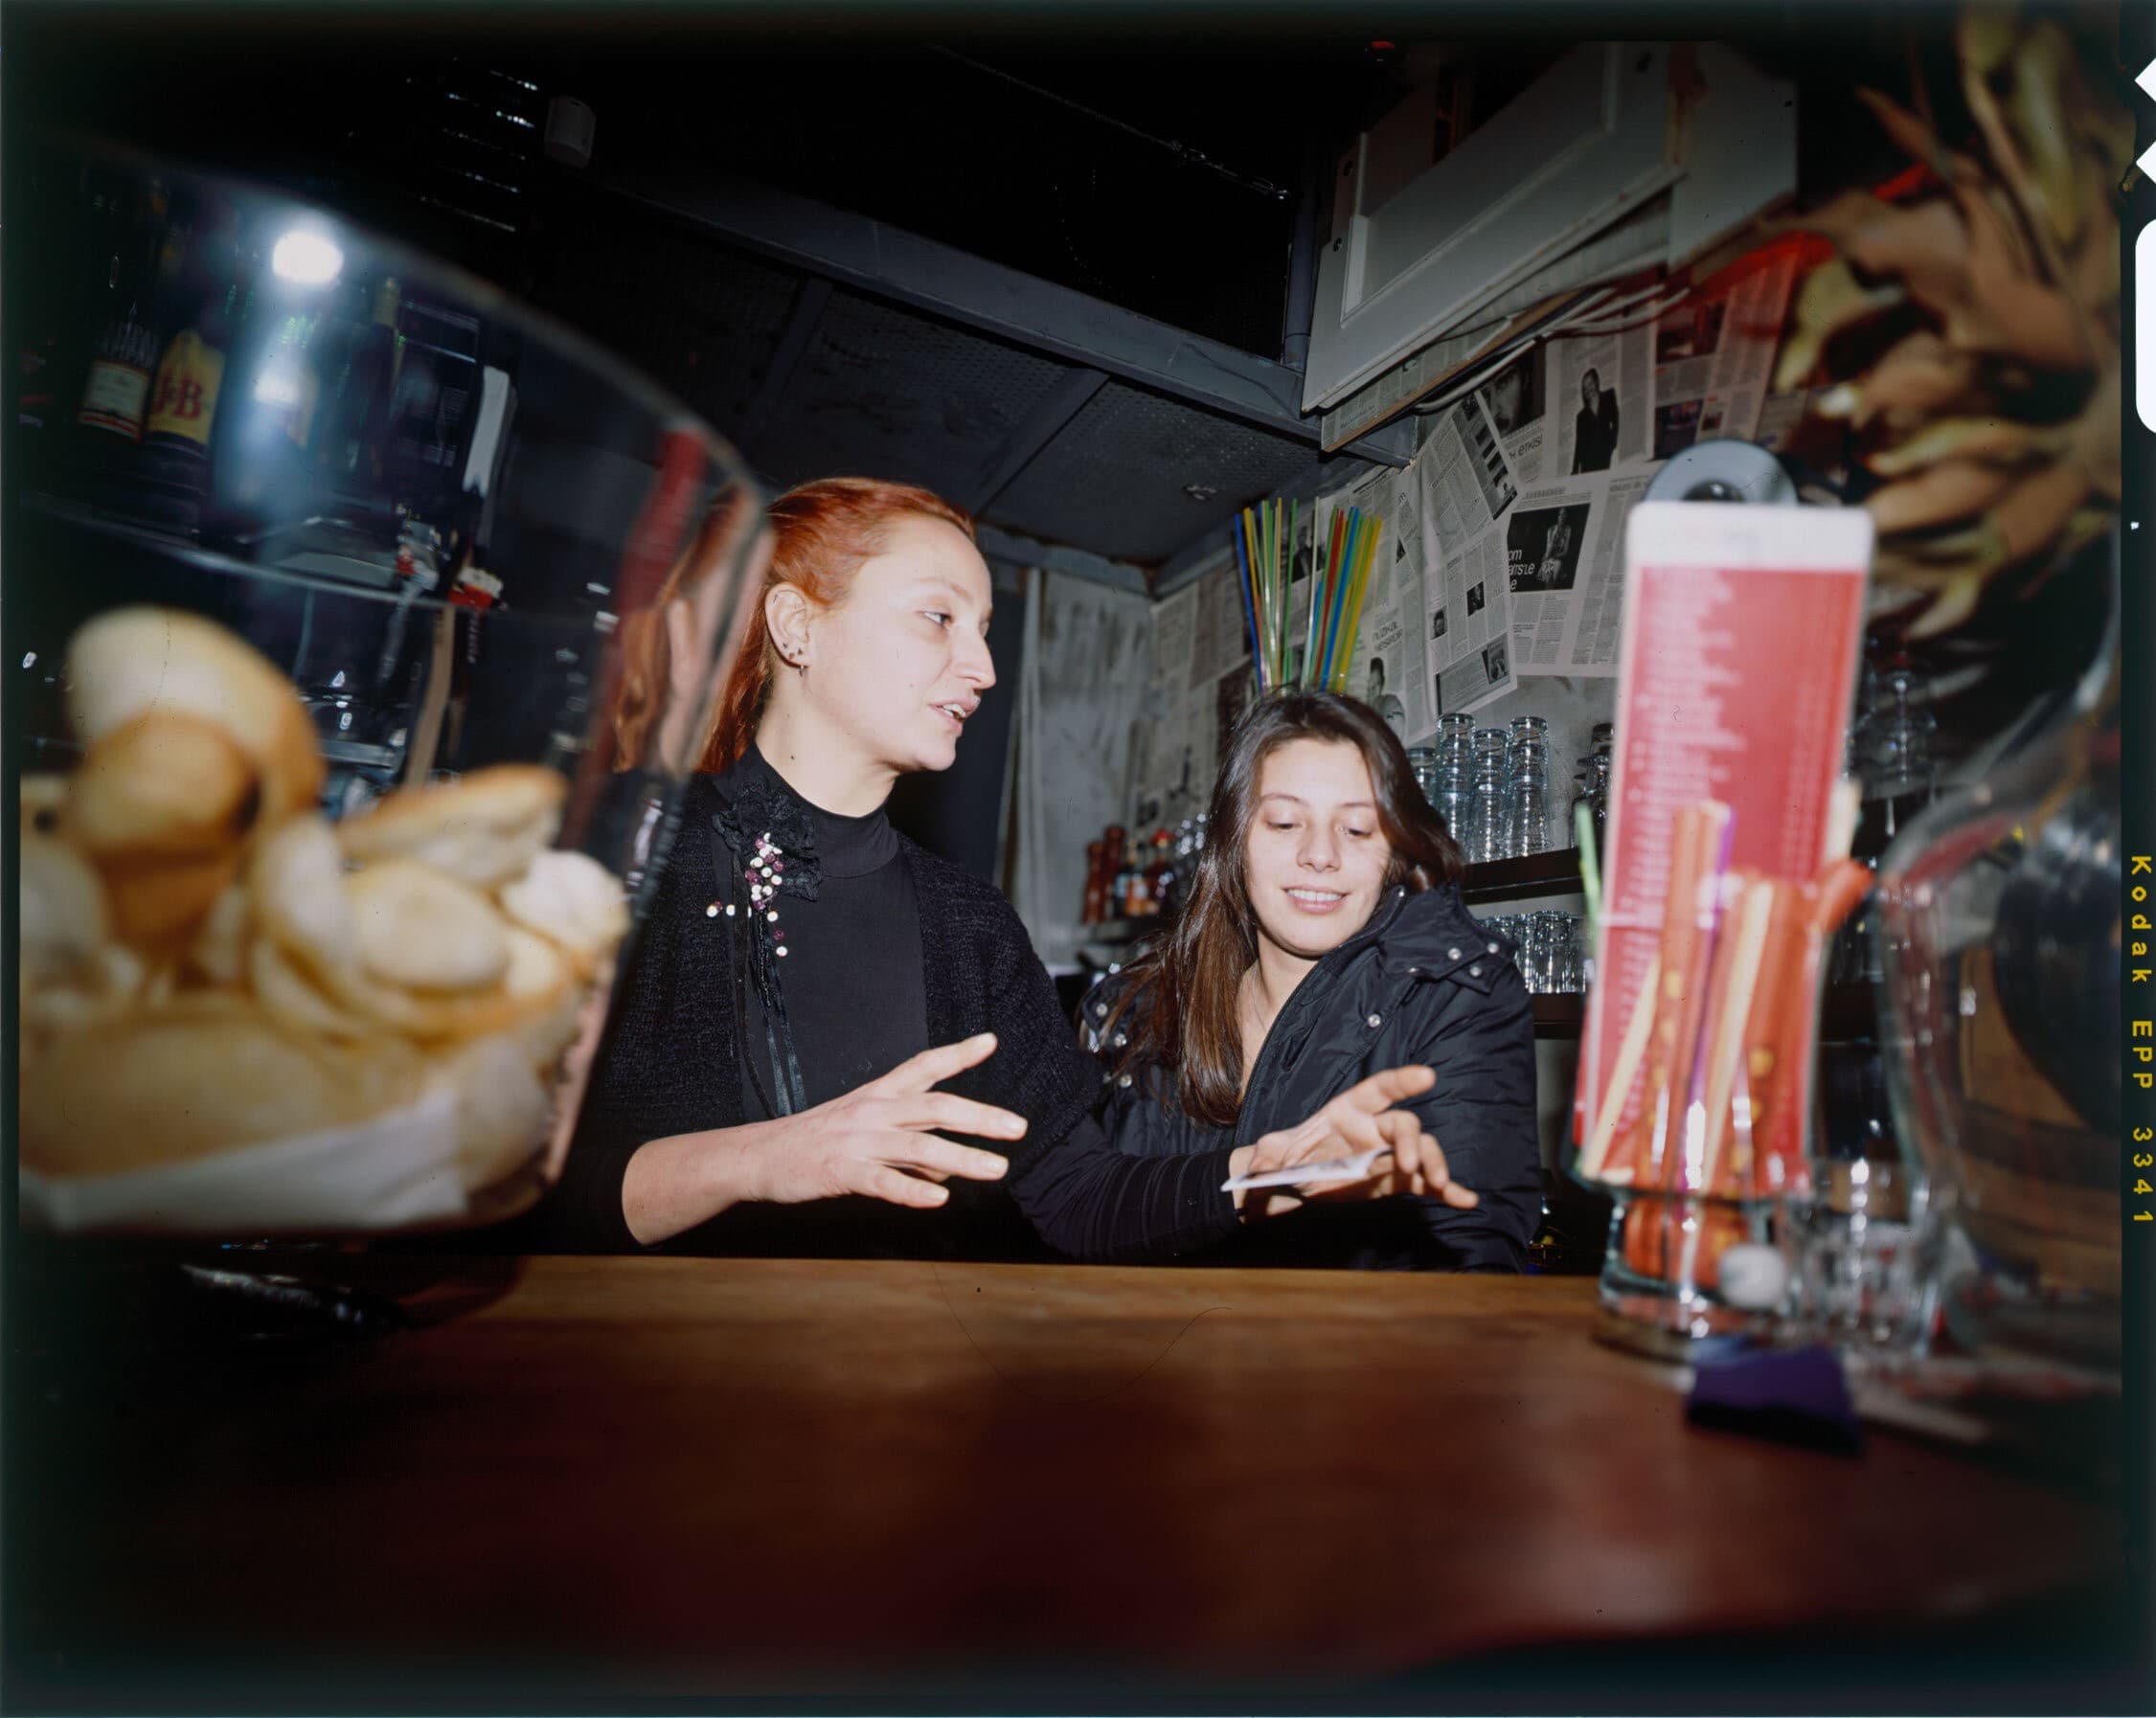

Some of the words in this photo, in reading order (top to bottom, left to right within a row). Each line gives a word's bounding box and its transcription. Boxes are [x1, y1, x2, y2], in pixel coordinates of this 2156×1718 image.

[2131, 856, 2151, 983] Kodak
[2132, 1020, 2152, 1089] EPP
[2133, 1127, 2153, 1221] 3341
